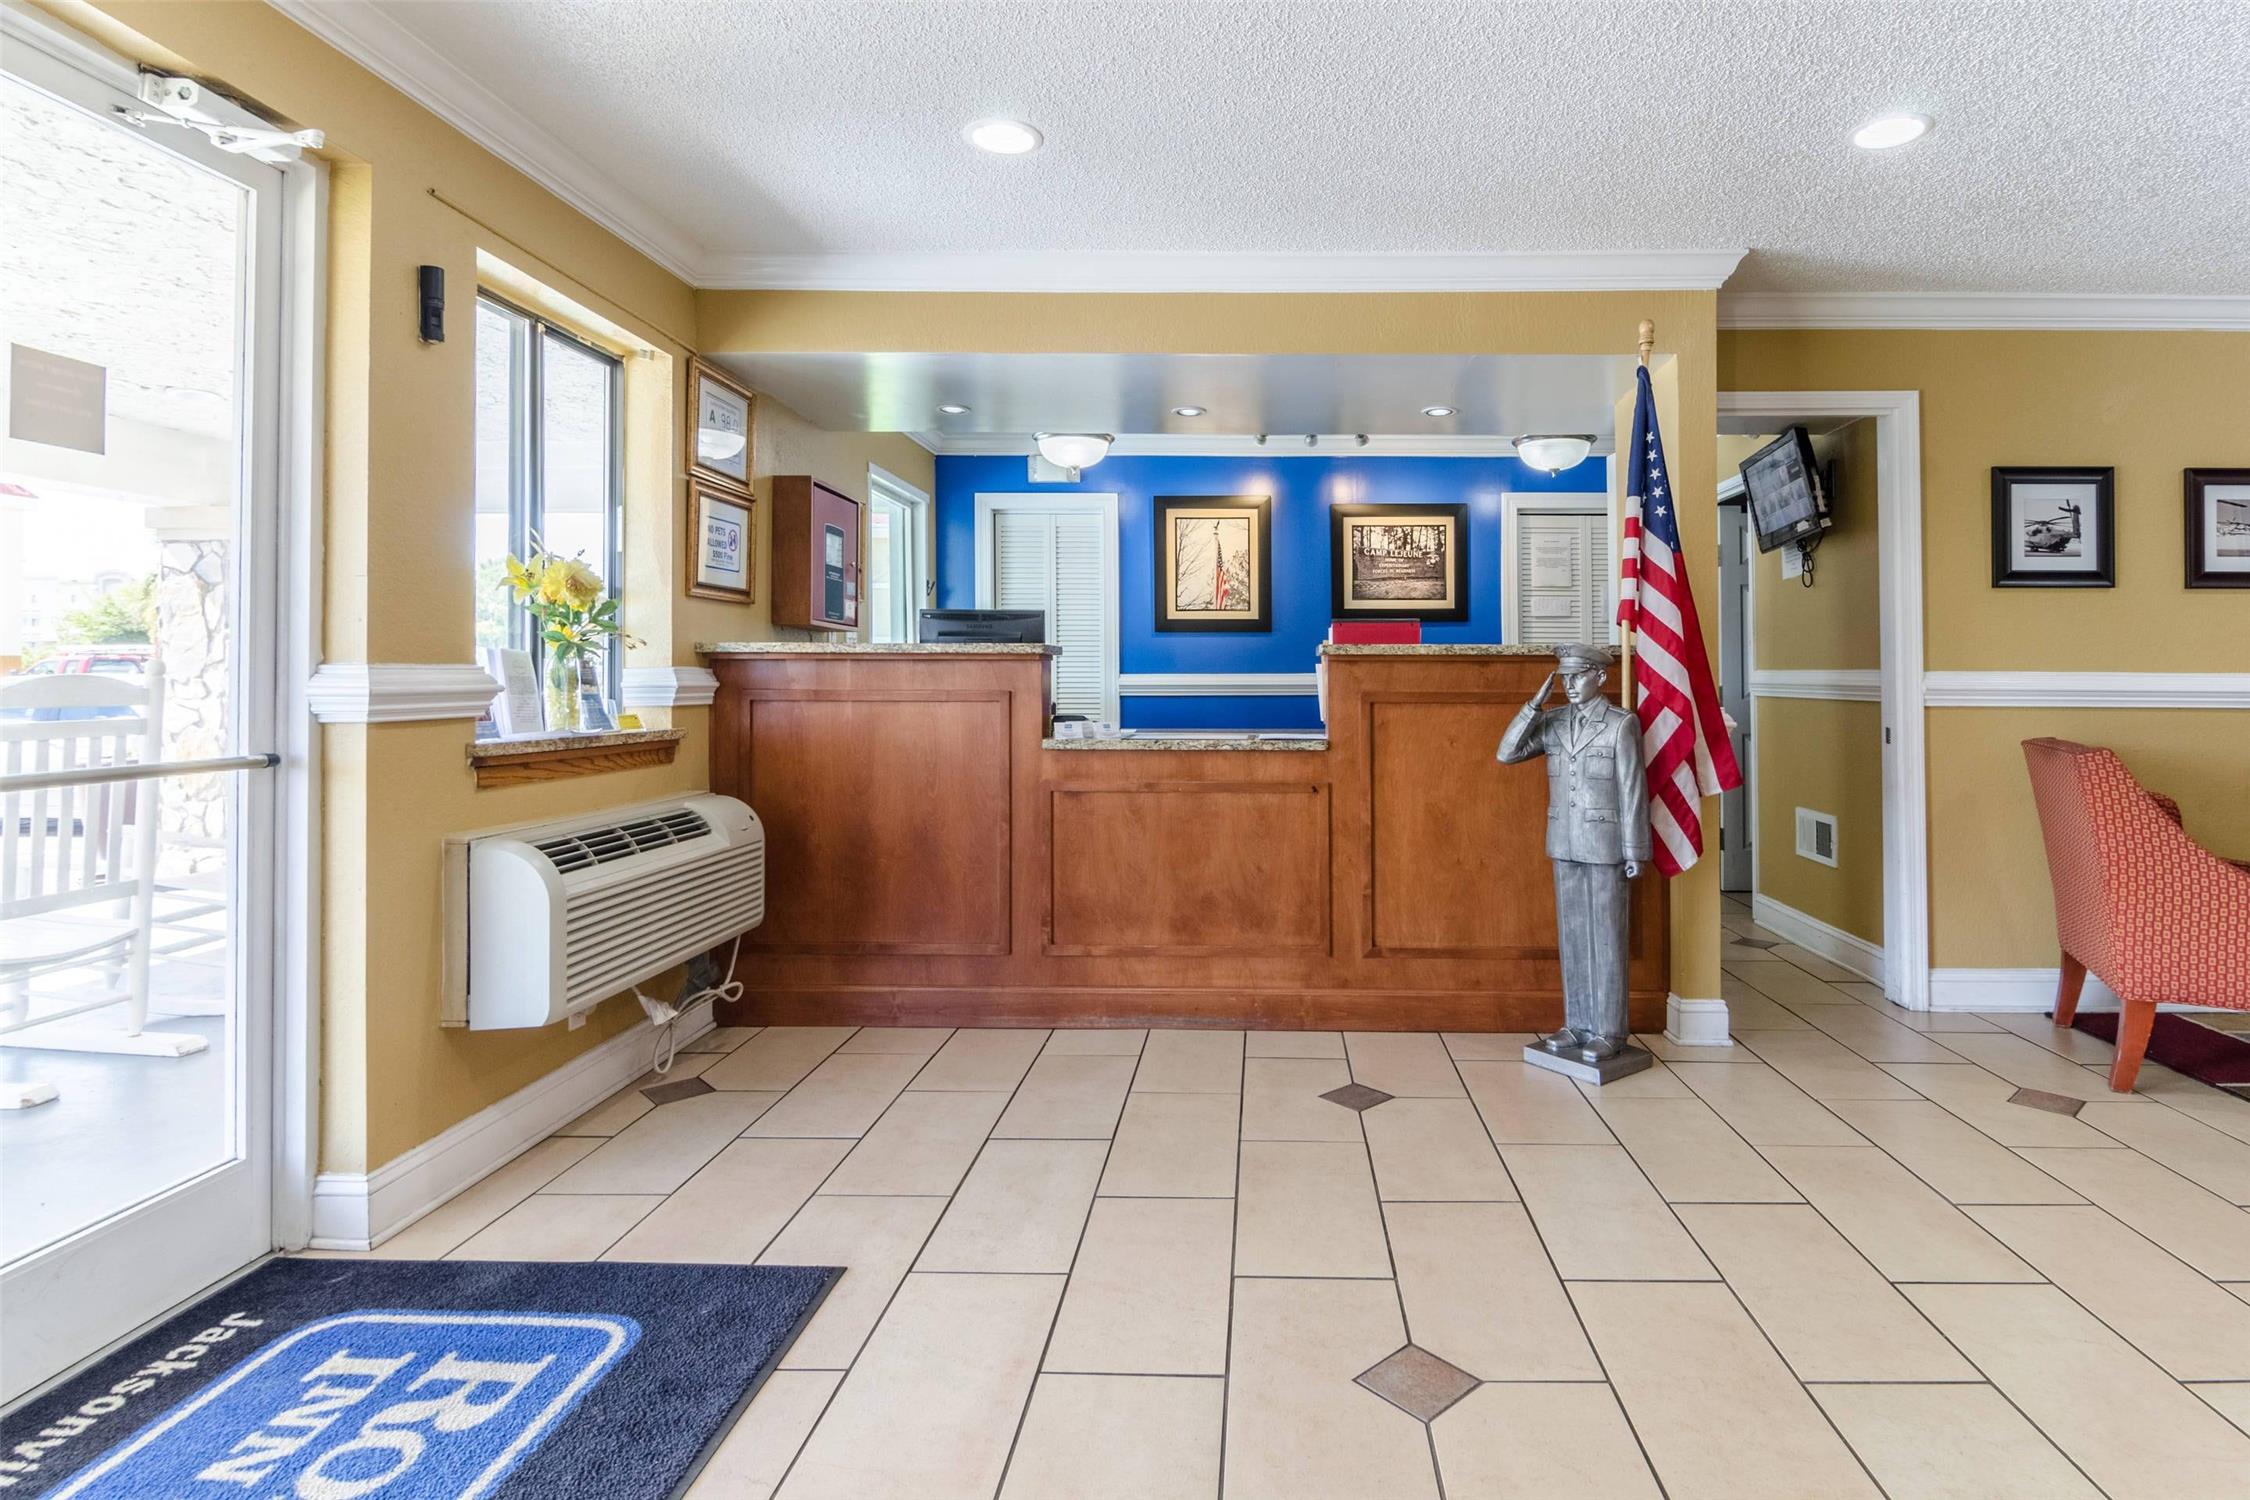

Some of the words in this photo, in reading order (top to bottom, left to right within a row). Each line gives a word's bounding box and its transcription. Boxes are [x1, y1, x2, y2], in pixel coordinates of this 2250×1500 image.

[709, 409, 716, 424] A
[715, 526, 726, 536] PETS
[1364, 548, 1388, 556] CAMP
[1390, 550, 1423, 558] LEJEUNE
[195, 1350, 417, 1488] INN
[274, 1350, 557, 1500] RO
